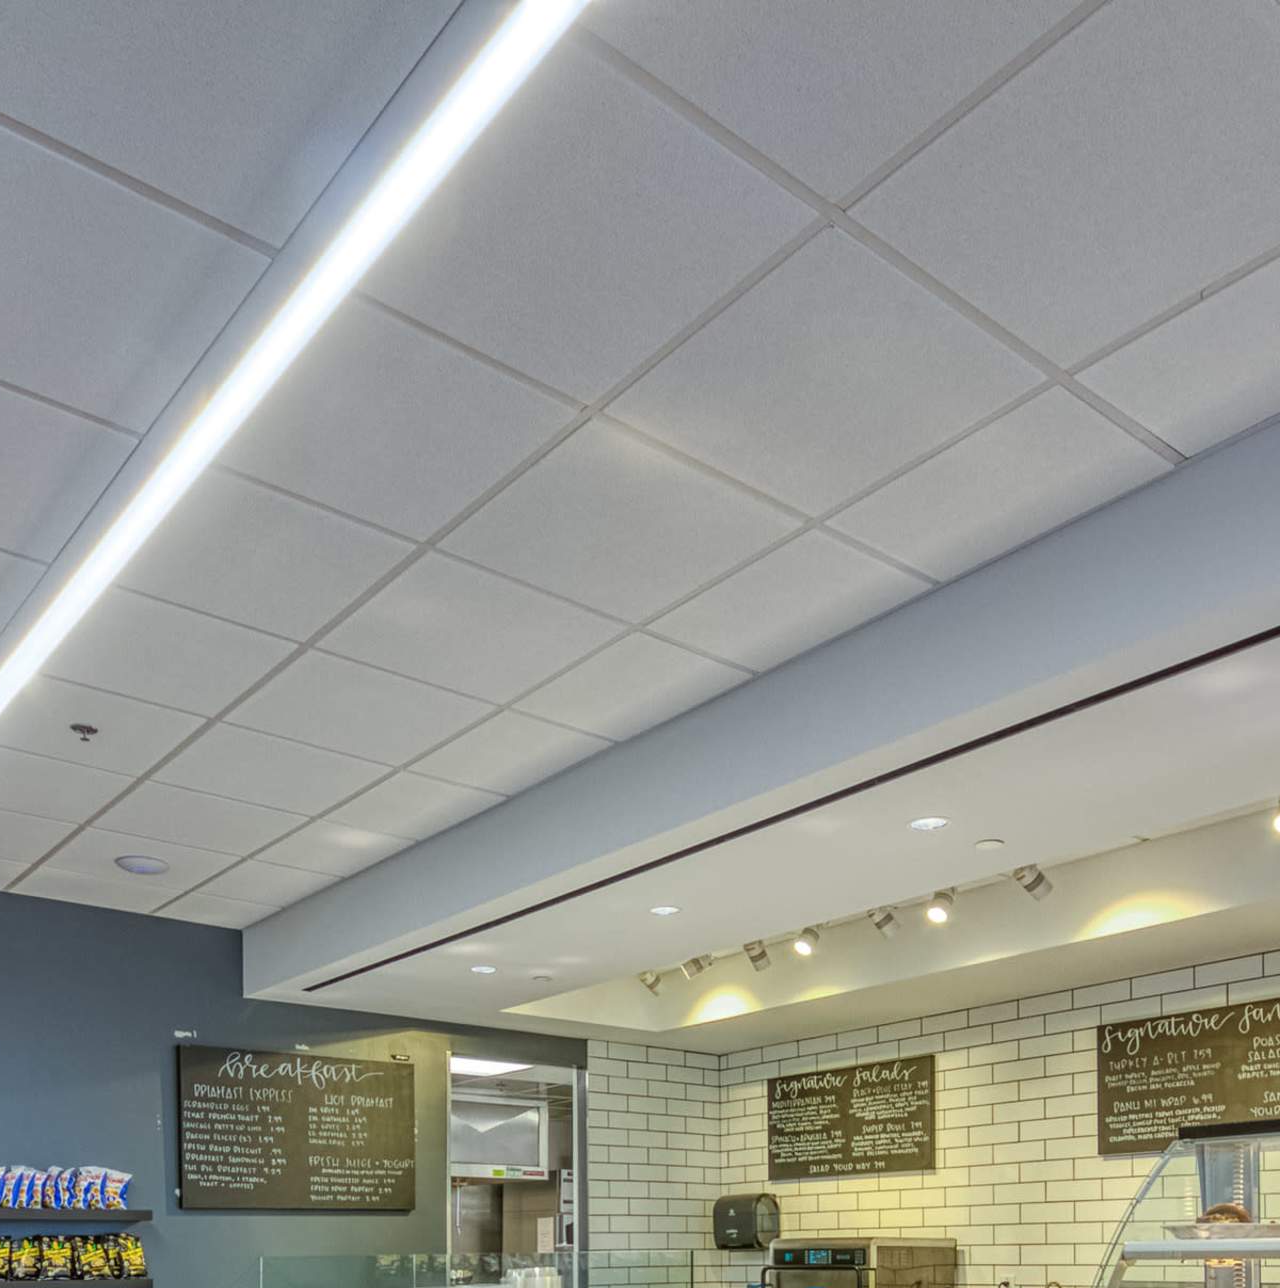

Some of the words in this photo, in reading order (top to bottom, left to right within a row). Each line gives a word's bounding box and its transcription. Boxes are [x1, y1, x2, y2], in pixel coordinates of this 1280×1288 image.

[218, 1052, 384, 1089] breakfast
[1110, 1056, 1147, 1071] TURKEY
[194, 1083, 243, 1099] BREAKFAST
[249, 1087, 293, 1103] EXPRESS
[1144, 1099, 1157, 1109] MI
[1160, 1095, 1186, 1107] WRAP
[1250, 1104, 1280, 1118] YOUR
